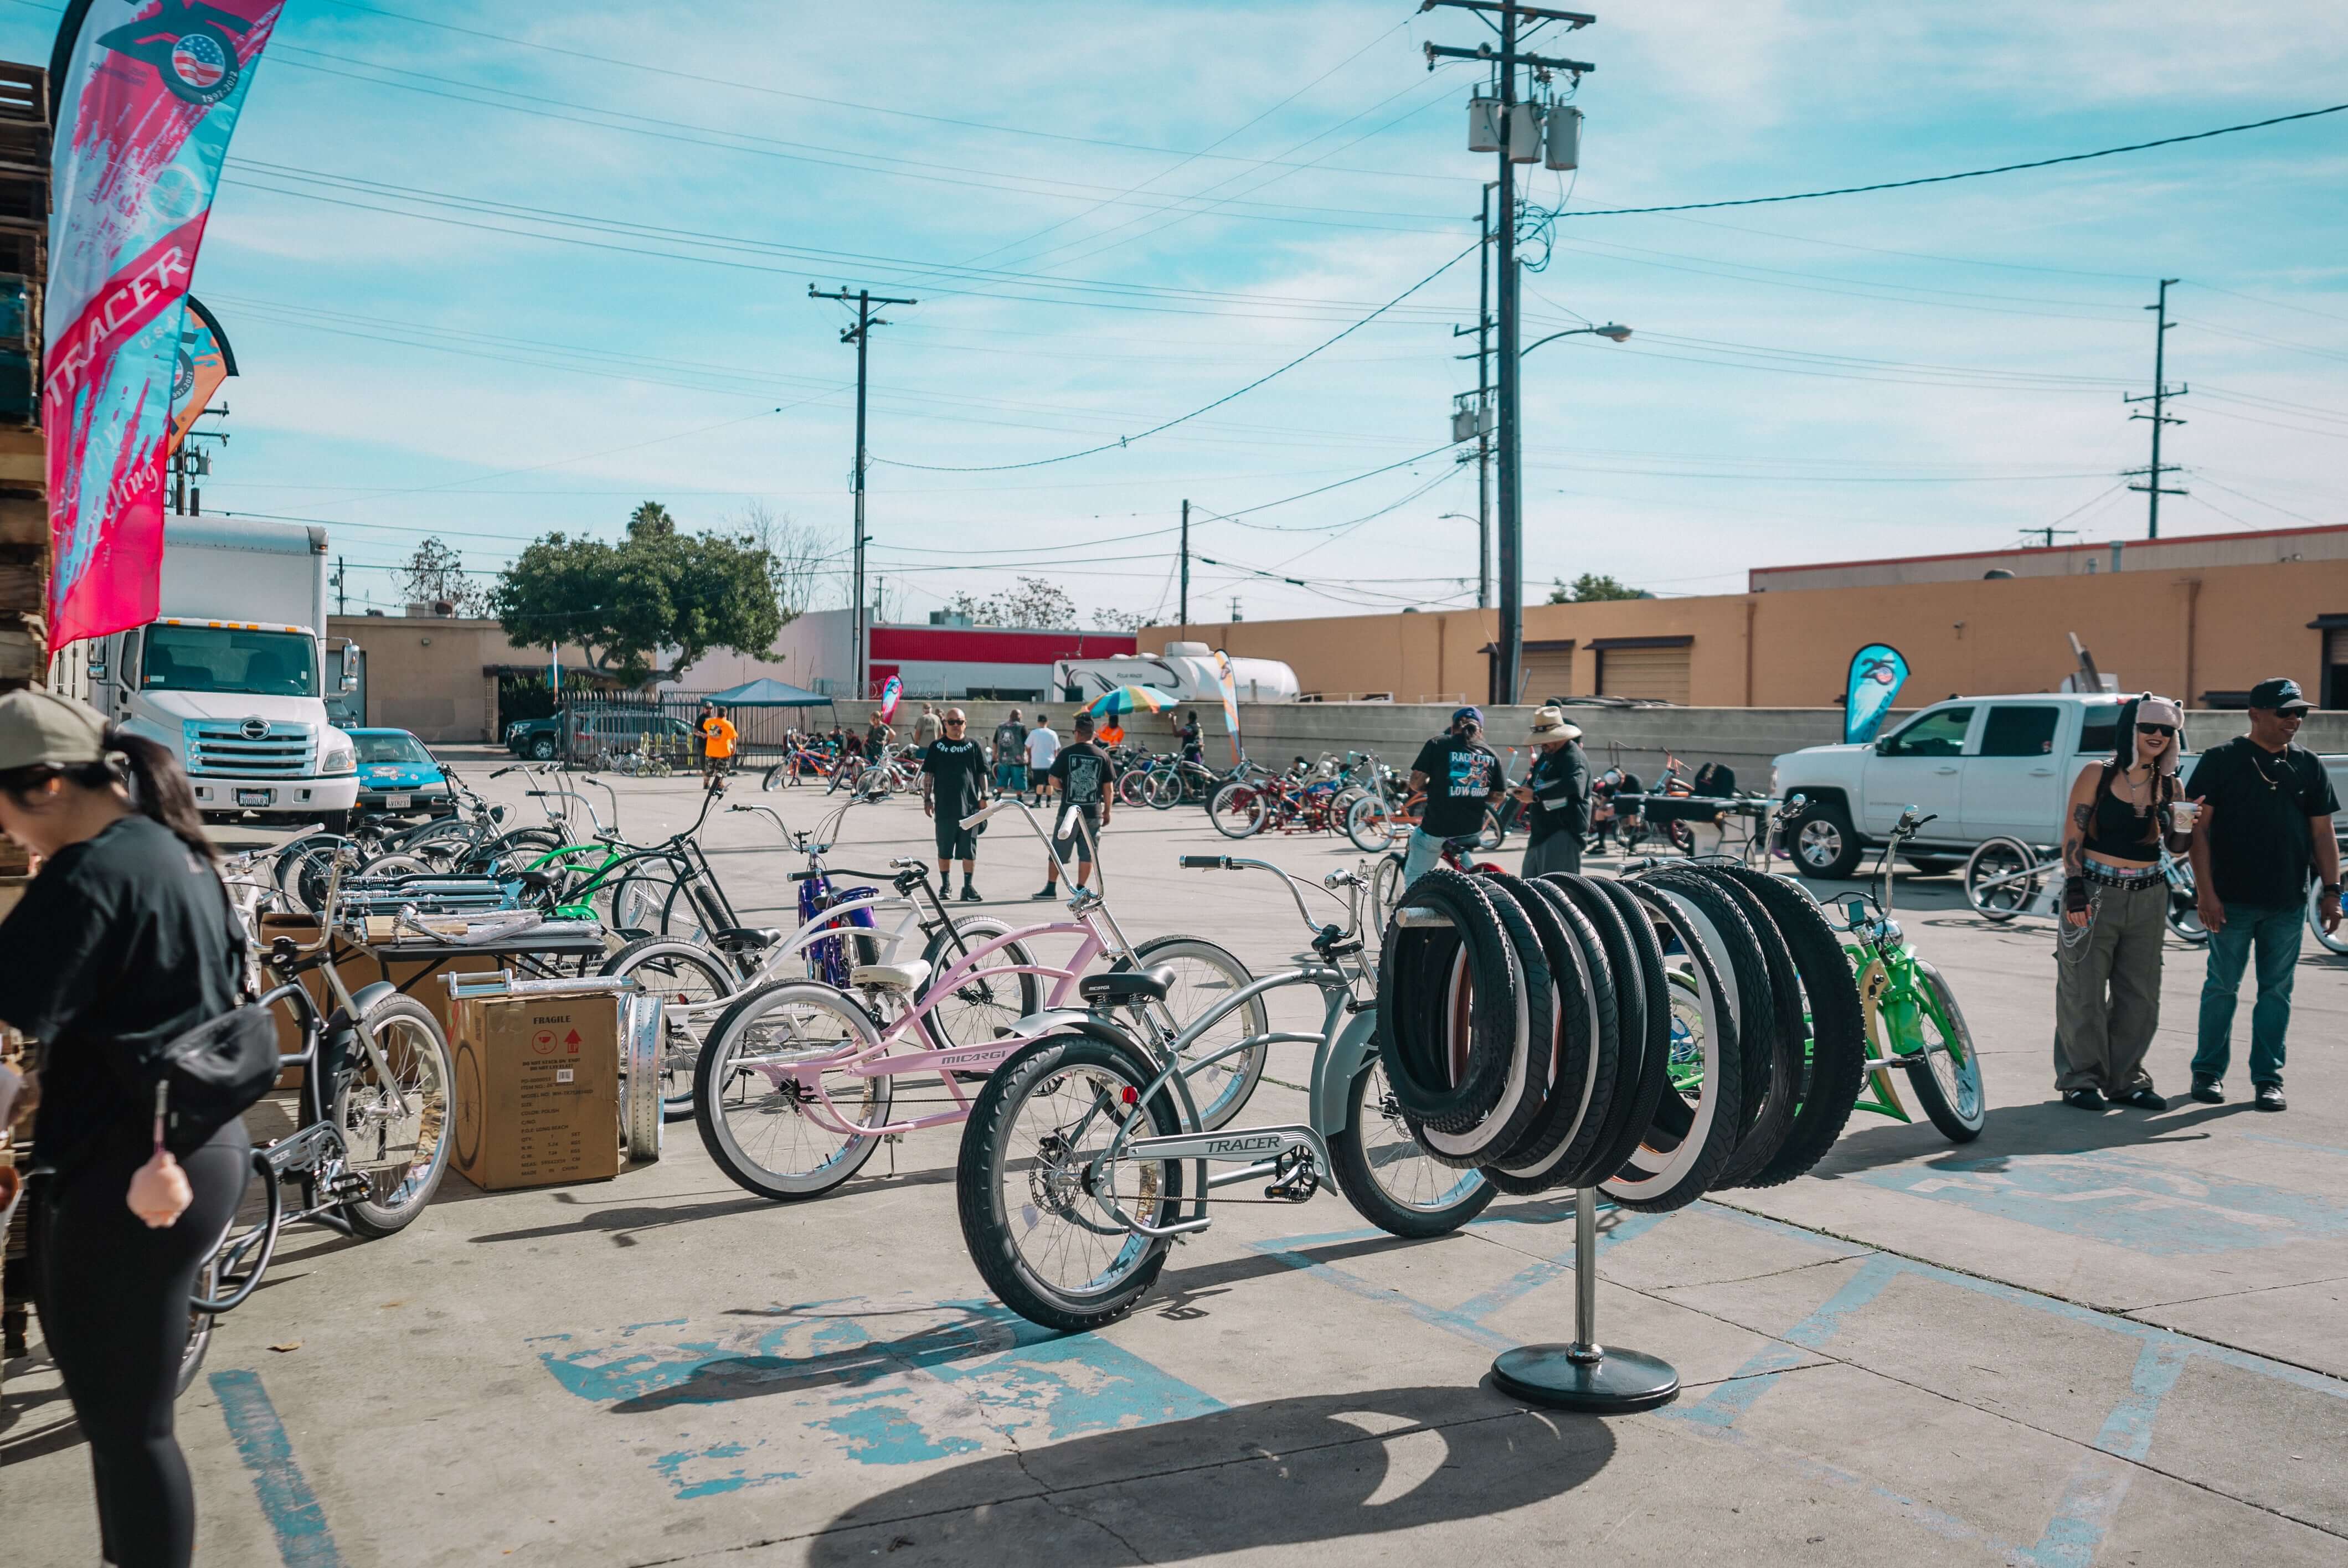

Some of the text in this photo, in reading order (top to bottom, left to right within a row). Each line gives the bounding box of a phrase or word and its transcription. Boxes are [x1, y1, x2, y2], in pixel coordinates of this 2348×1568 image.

[43, 246, 190, 407] TRACER
[173, 371, 193, 399] 997-2022
[936, 742, 972, 752] The Others
[1450, 786, 1470, 796] LOW
[533, 1015, 571, 1024] FRAGILE
[941, 1050, 1007, 1064] MICARGI
[1205, 1137, 1280, 1153] TRACER
